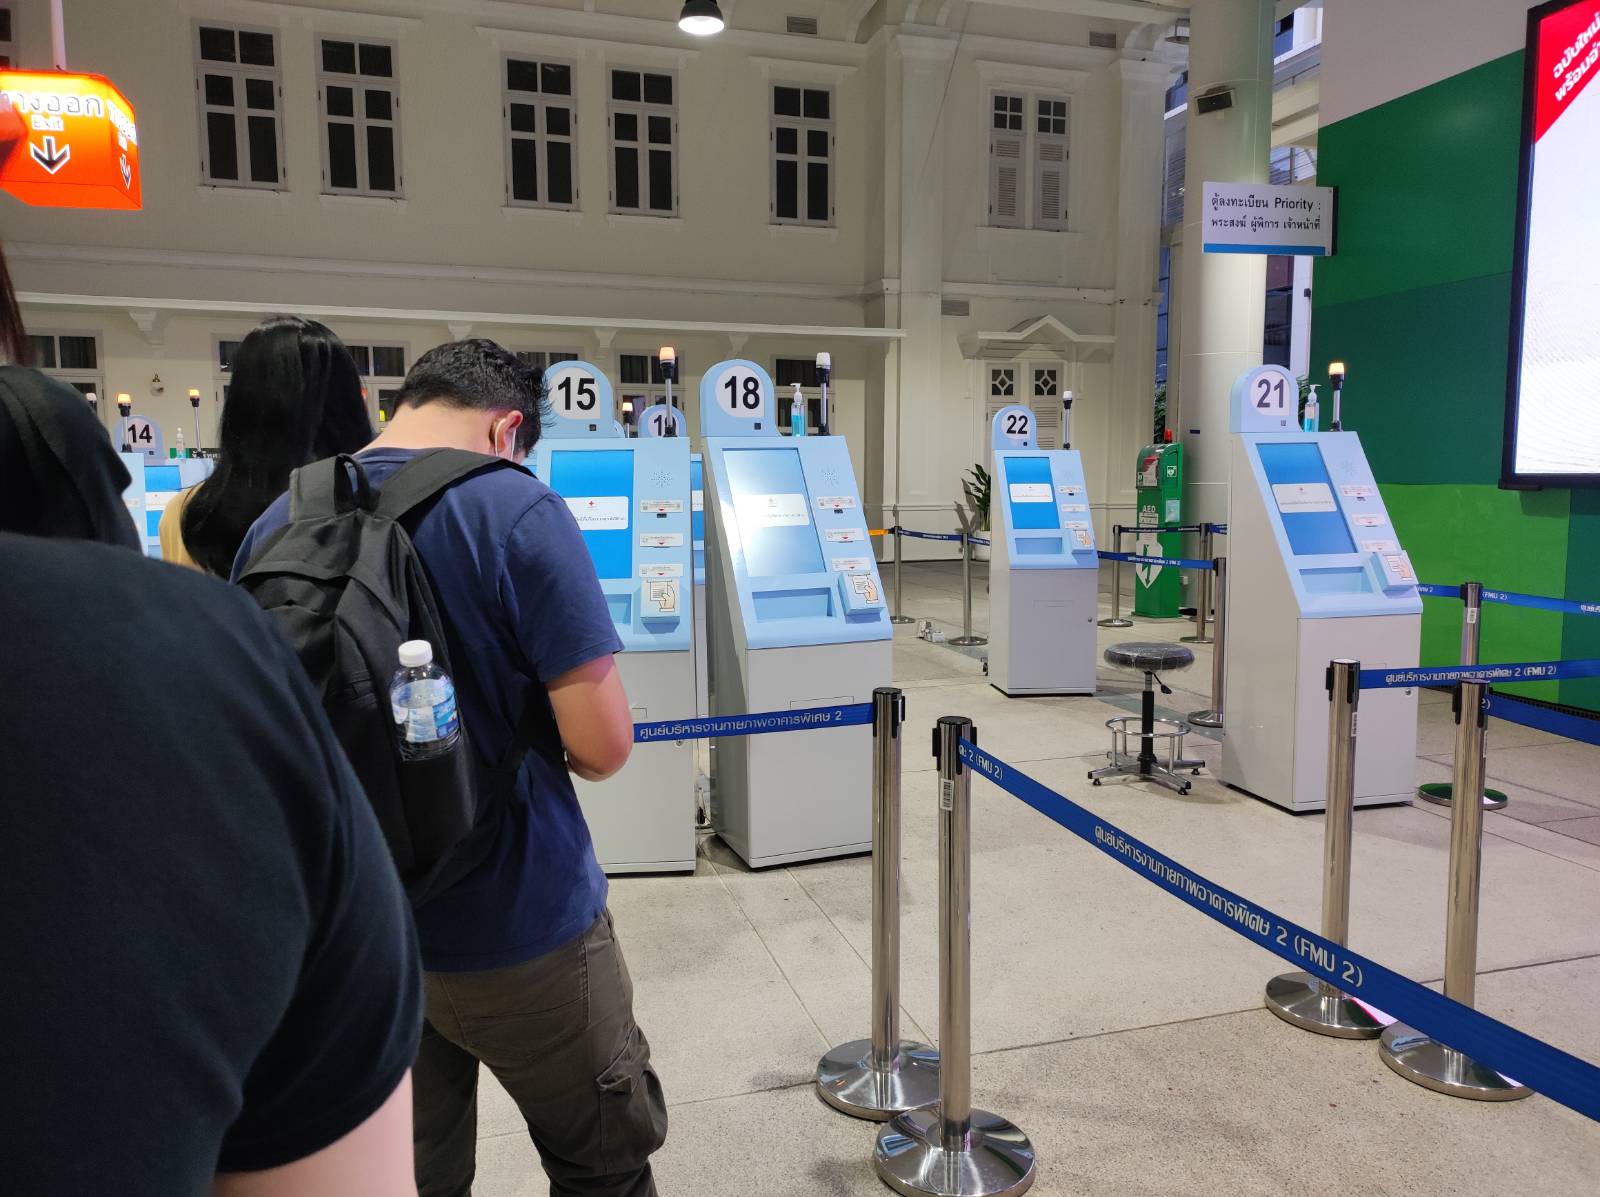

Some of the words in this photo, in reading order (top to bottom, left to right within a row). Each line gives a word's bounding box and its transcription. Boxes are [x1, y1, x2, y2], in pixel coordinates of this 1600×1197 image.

[1554, 40, 1600, 101] พร้อมอ่
[1211, 192, 1269, 211] ตู้ลงทะเบียน
[1274, 197, 1314, 212] Priority
[1211, 214, 1246, 228] พระสงฆ์
[1250, 216, 1280, 232] ผู้พิการ
[1283, 215, 1321, 230] เจ้าหน้าที่
[557, 376, 596, 411] 15
[724, 375, 760, 410] 18
[1256, 378, 1284, 409] 21
[128, 424, 153, 443] 14
[1006, 414, 1029, 435] 22
[1142, 504, 1156, 513] AED
[1514, 667, 1521, 677] 2
[1523, 666, 1545, 677] (FMU
[1547, 665, 1557, 675] 2)
[639, 710, 831, 739] ศูนย์บริหารงานกายภาพอาคารพิเศษ
[834, 710, 843, 721] 2
[969, 749, 974, 763] 2
[975, 753, 993, 774] (FMU
[994, 765, 1003, 781] 2)
[1094, 824, 1270, 936] ศูนย์บริหารงานกายภาพอาคารพิเศษ
[1275, 925, 1288, 947] 2
[1294, 934, 1336, 973] (FMU
[1341, 960, 1364, 988] 2)
